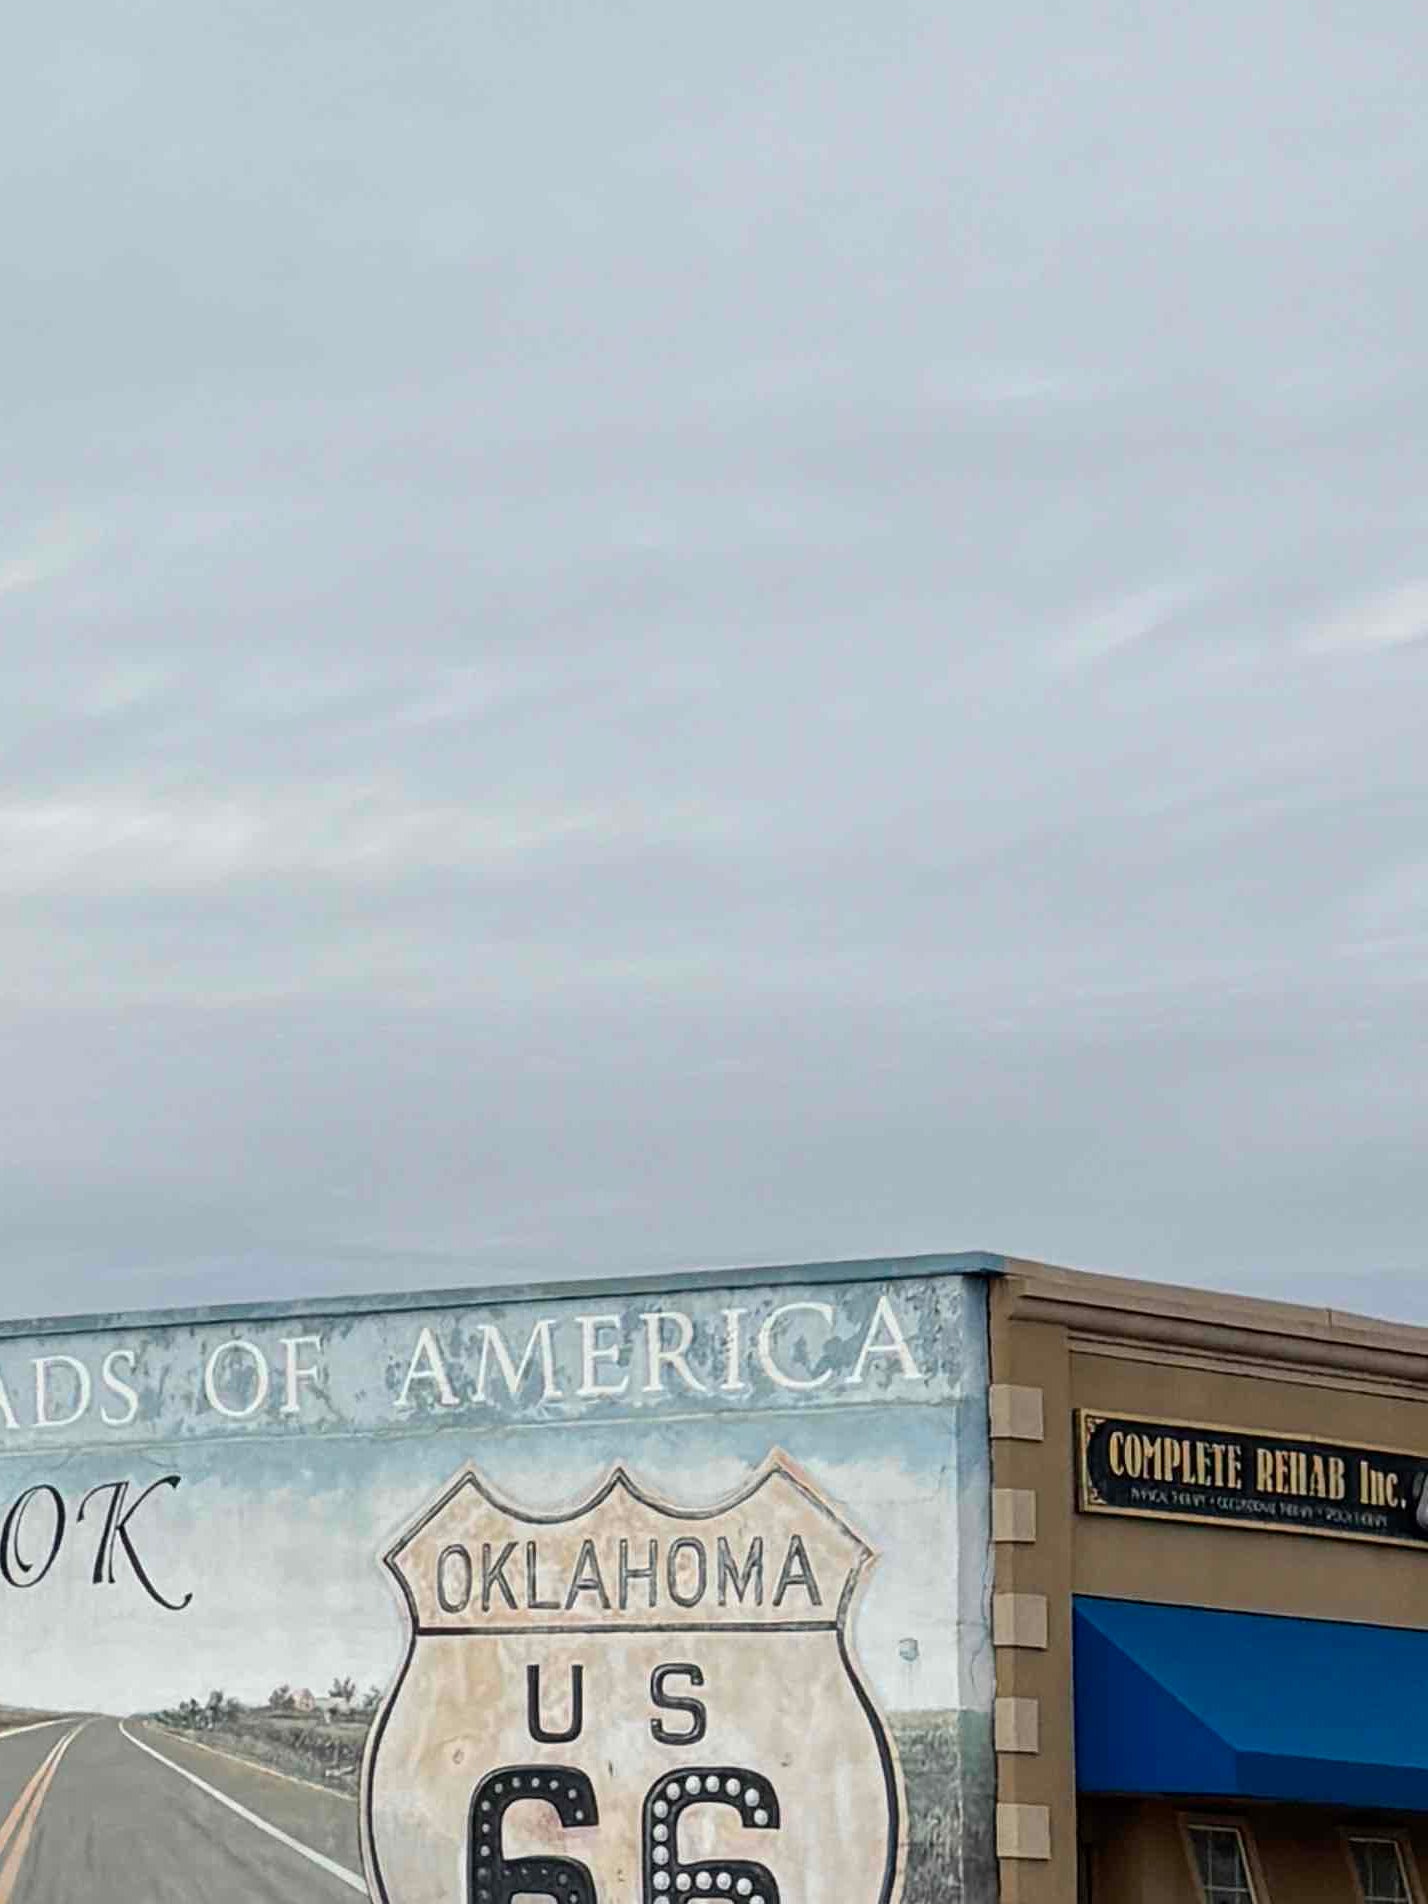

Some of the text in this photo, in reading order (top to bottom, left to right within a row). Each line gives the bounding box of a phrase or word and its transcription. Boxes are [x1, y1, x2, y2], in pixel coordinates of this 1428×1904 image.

[203, 1334, 322, 1418] OF
[394, 1295, 923, 1407] AMERICA
[1108, 1431, 1242, 1490] COMPLETE
[1256, 1448, 1345, 1501] REHAB
[1359, 1460, 1408, 1511] Inc.
[435, 1533, 823, 1614] OKLAHOMA
